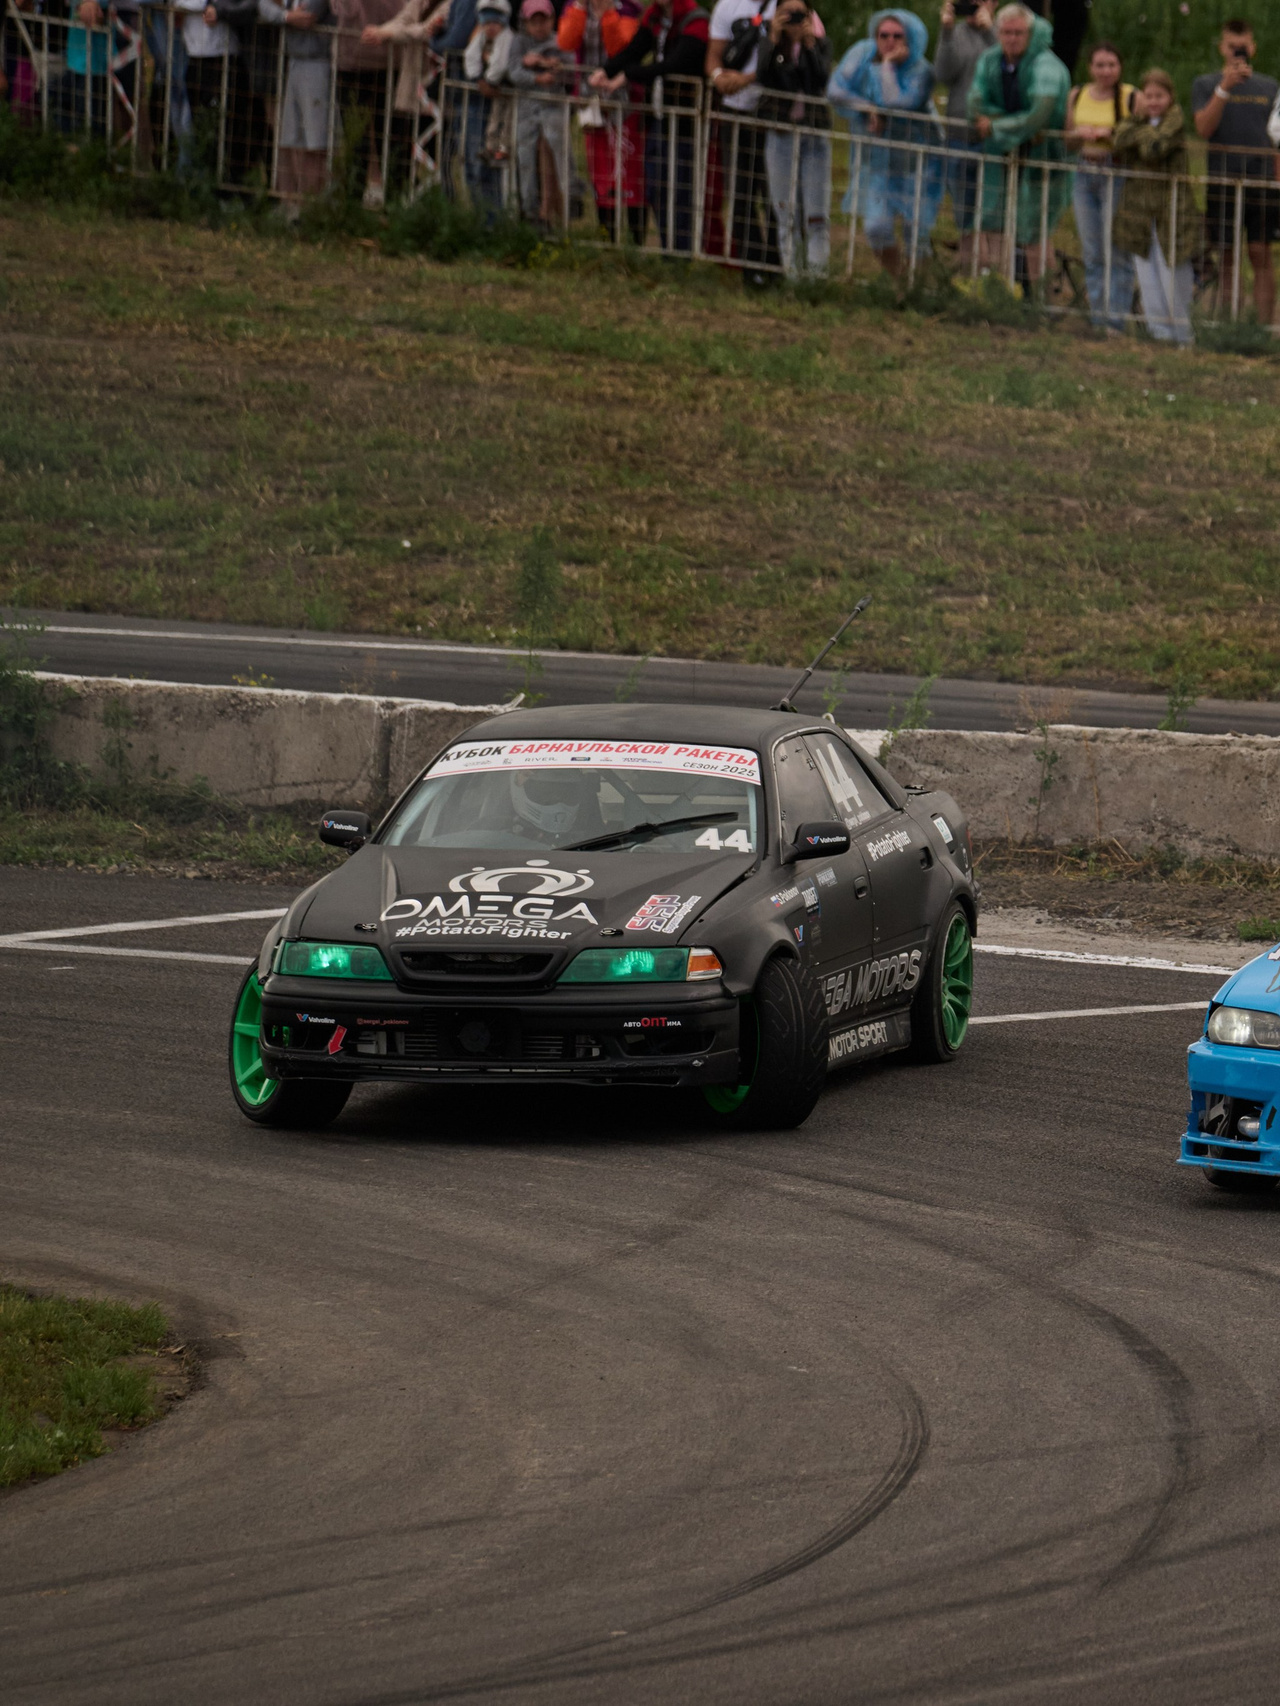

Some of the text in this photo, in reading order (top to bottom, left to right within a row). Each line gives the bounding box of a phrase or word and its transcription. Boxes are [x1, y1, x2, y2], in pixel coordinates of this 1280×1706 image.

[440, 743, 758, 766] КУБОК БАРНАУЛЬСКОЙ РАКЕТЫ
[683, 761, 757, 778] СЕЗОН 2025
[816, 743, 863, 812] 44
[695, 828, 753, 853] 44
[820, 836, 847, 844] Valvoline
[380, 895, 599, 925] OMEGA
[395, 925, 572, 940] #PotatoFighter
[415, 917, 548, 929] MOTORS
[851, 949, 922, 1007] MOTORS
[828, 1021, 888, 1061] MOTOR SPORT
